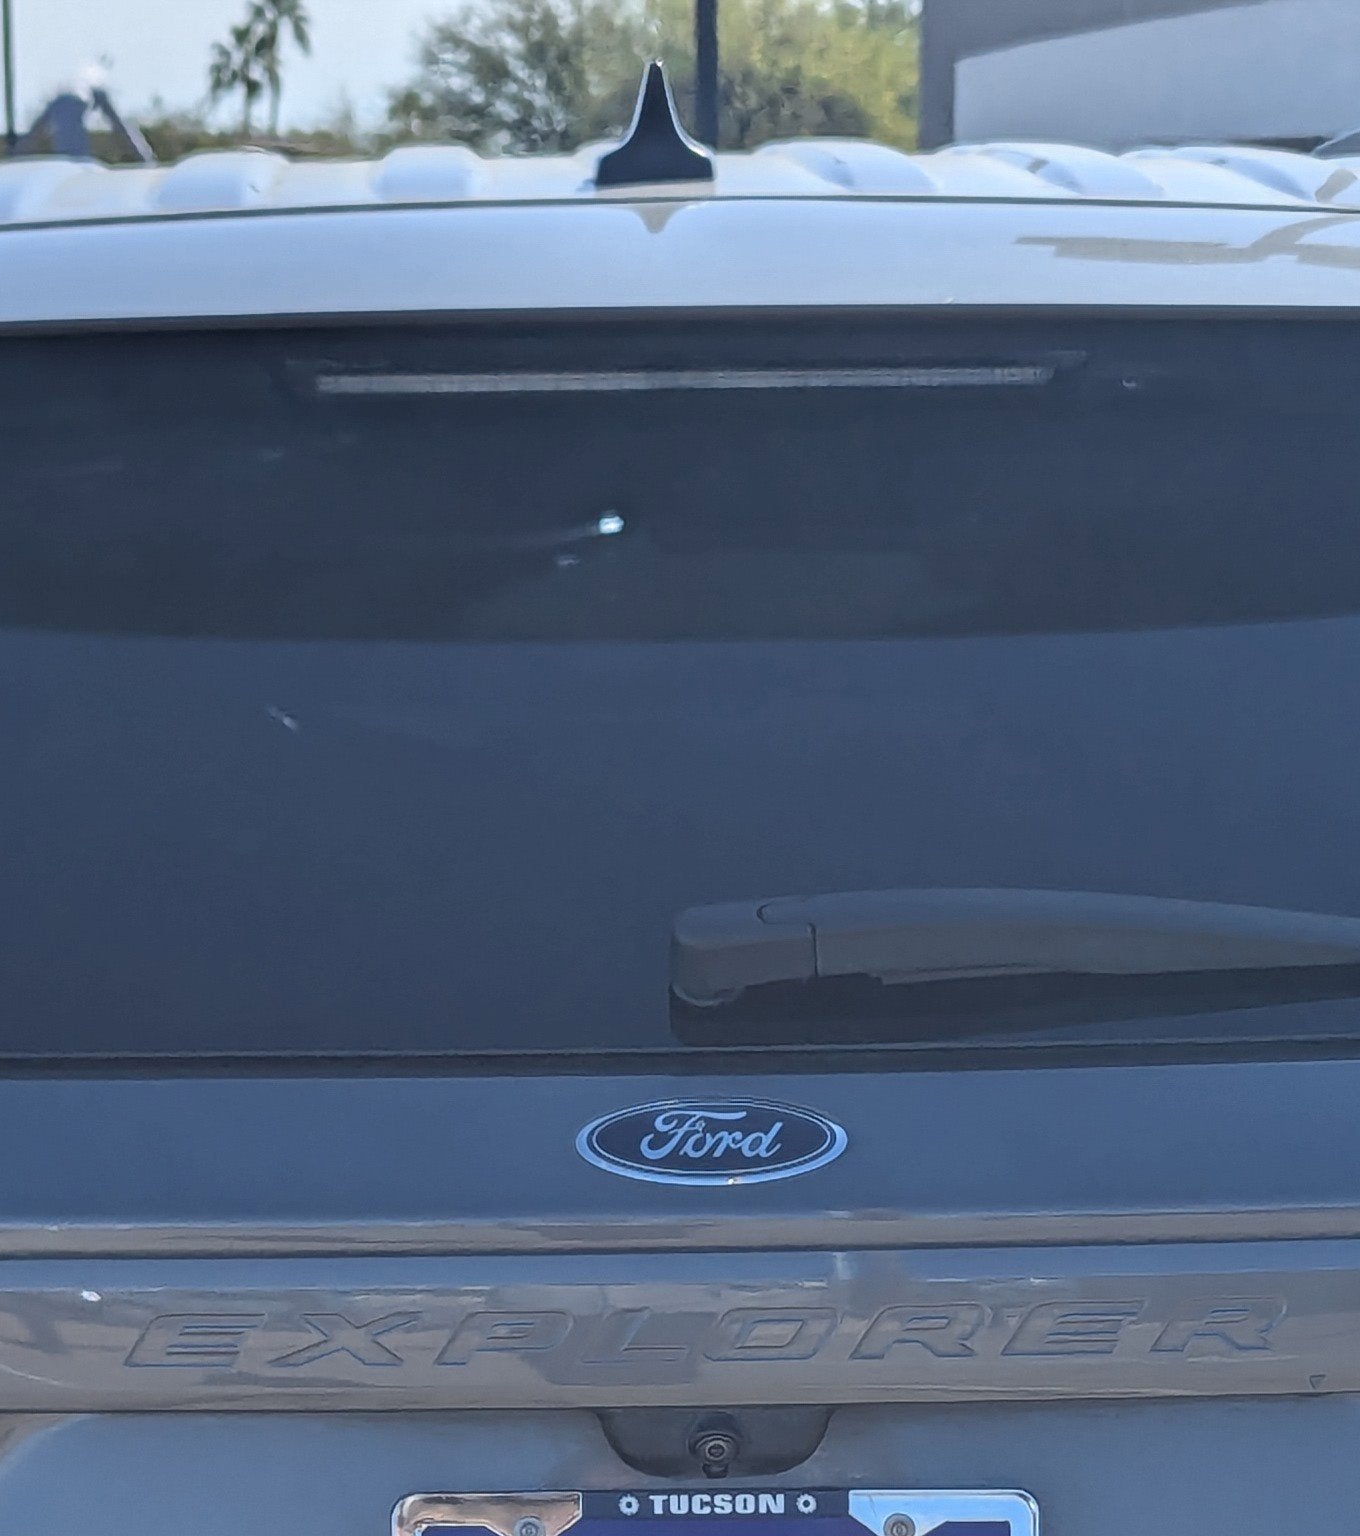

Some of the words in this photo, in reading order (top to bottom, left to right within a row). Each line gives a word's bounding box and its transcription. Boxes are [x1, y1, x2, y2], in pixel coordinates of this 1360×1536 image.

[640, 1110, 783, 1159] Ford
[123, 1296, 1290, 1369] EXPLORER
[648, 1493, 786, 1515] TUCSON
